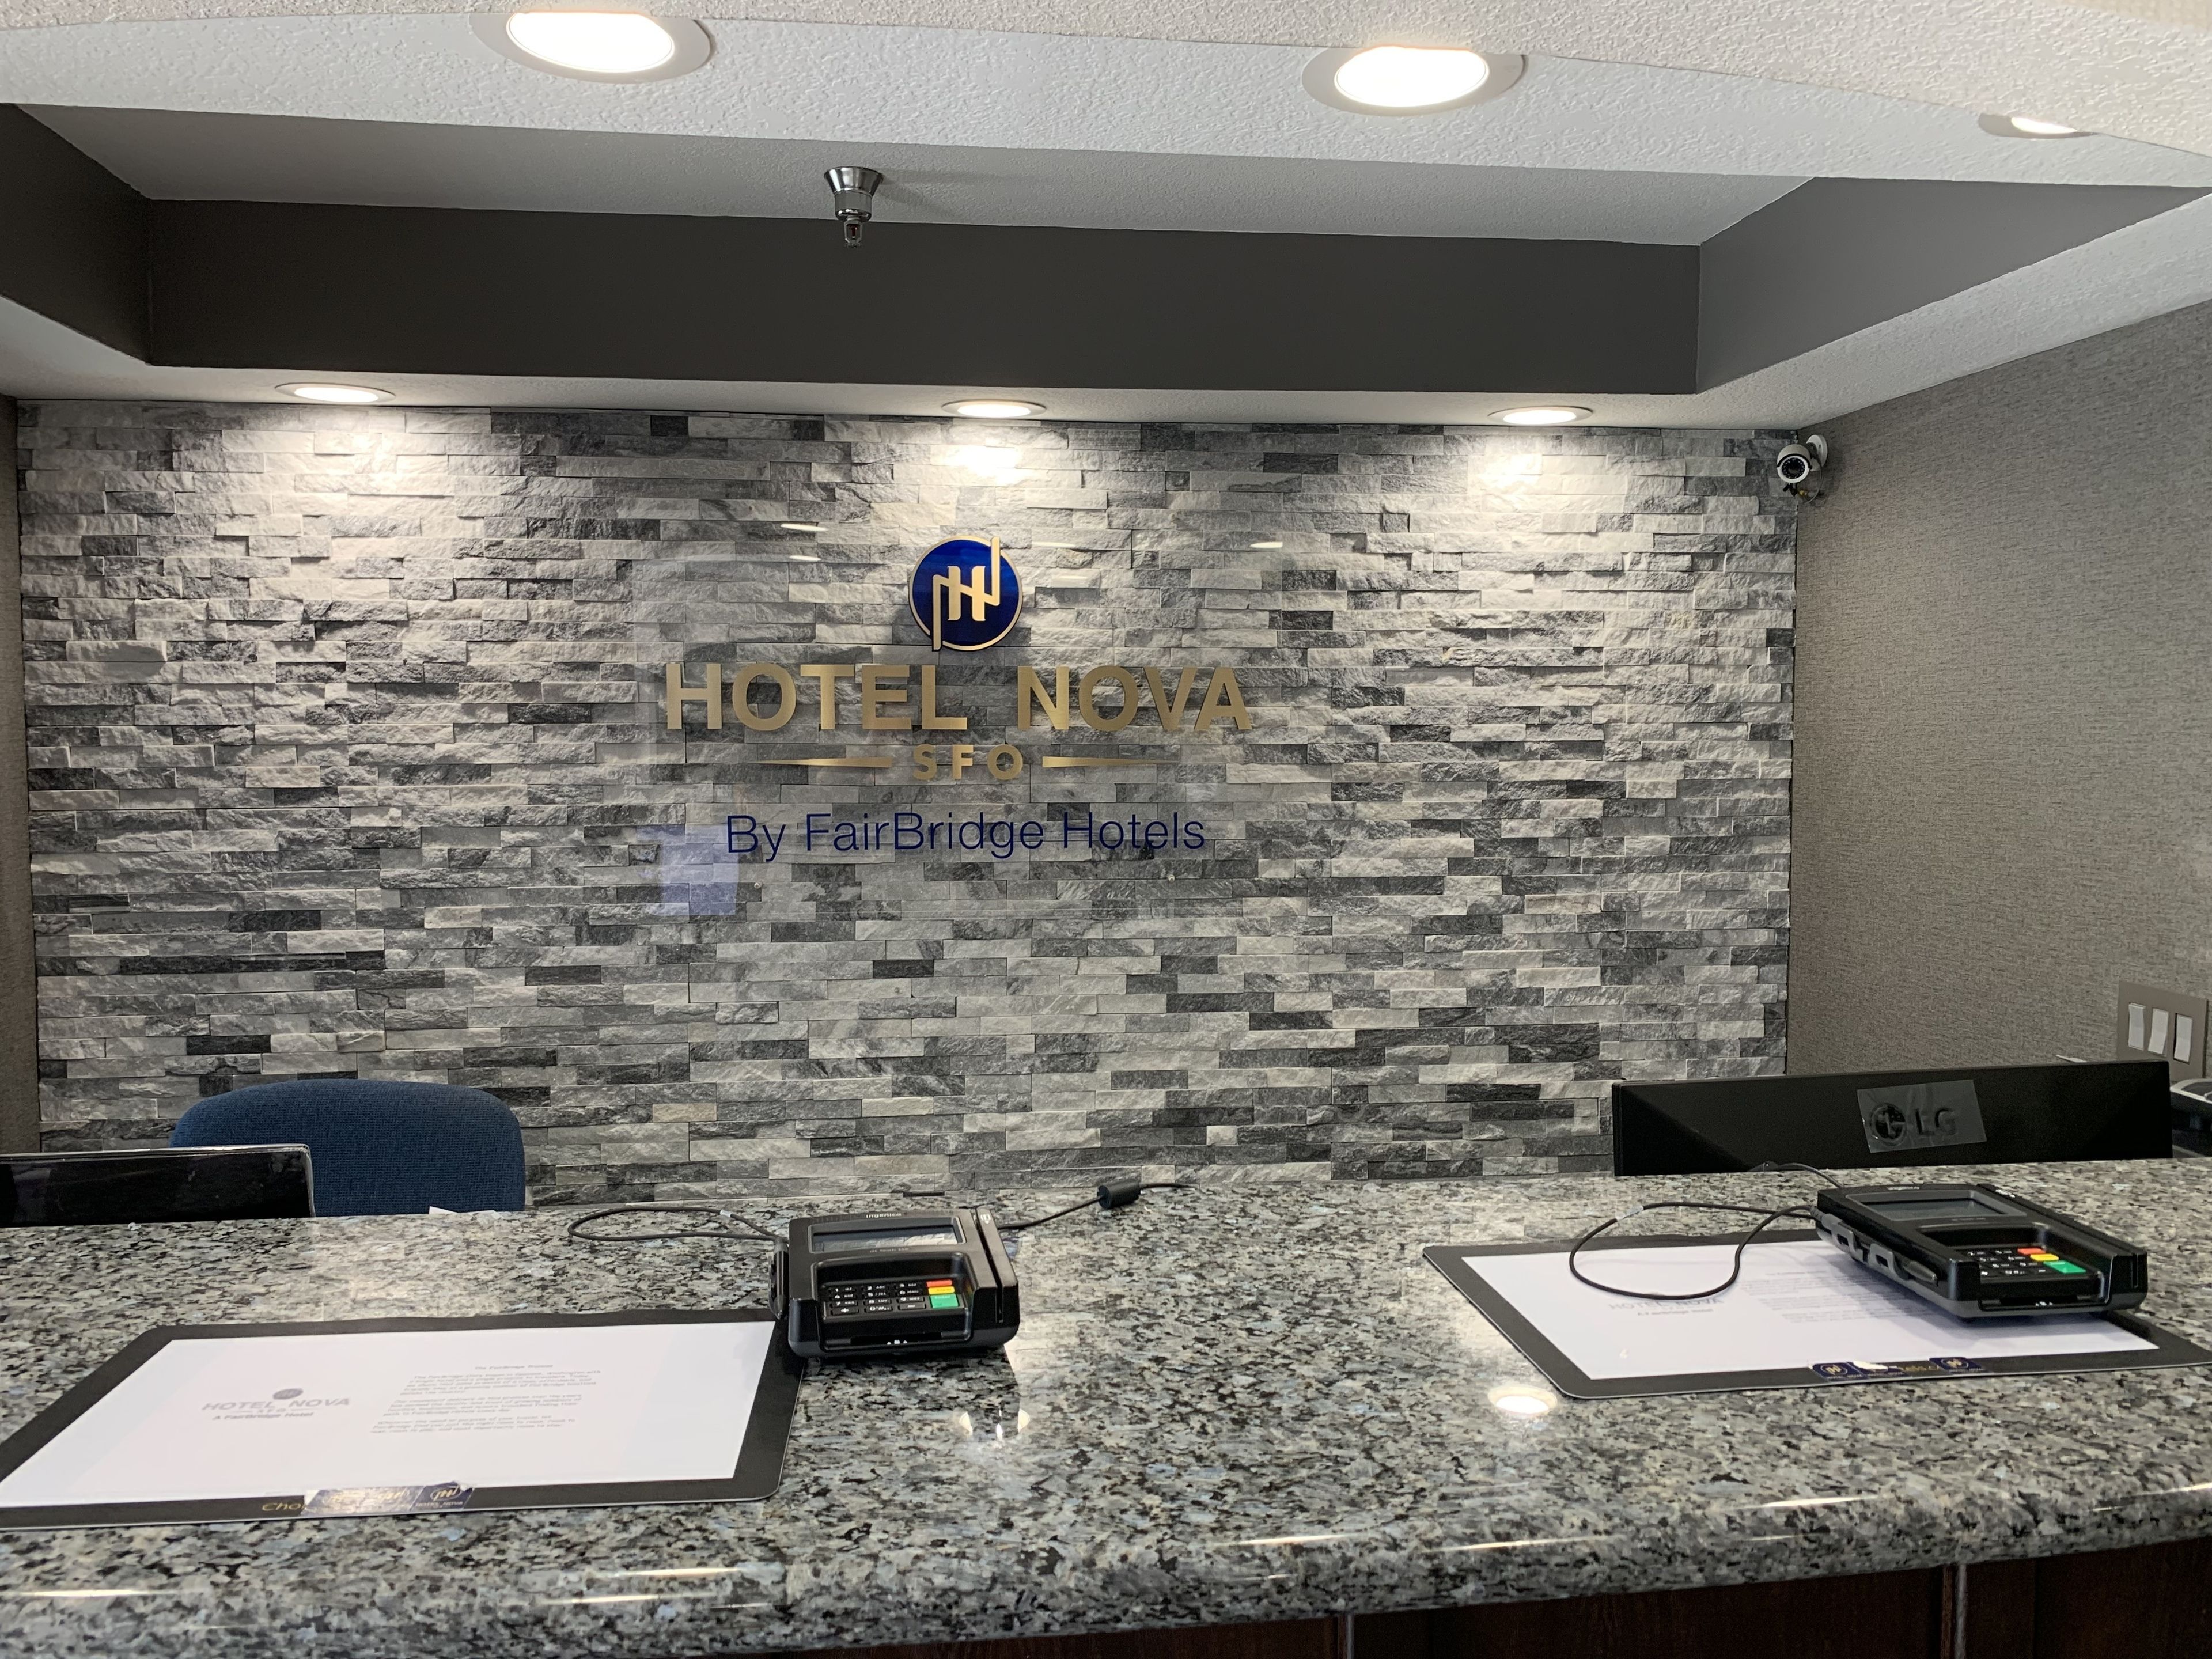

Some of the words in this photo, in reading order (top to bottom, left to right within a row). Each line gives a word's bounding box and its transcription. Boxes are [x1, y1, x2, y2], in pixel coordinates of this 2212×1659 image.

[665, 662, 968, 730] HOTEL
[1017, 665, 1253, 732] NOVA
[912, 743, 1025, 781] SFO
[726, 814, 786, 862] By
[806, 812, 1045, 860] FairBridge
[1062, 811, 1206, 850] Hotels
[202, 1400, 275, 1411] HOTEL
[288, 1396, 350, 1407] NOVA
